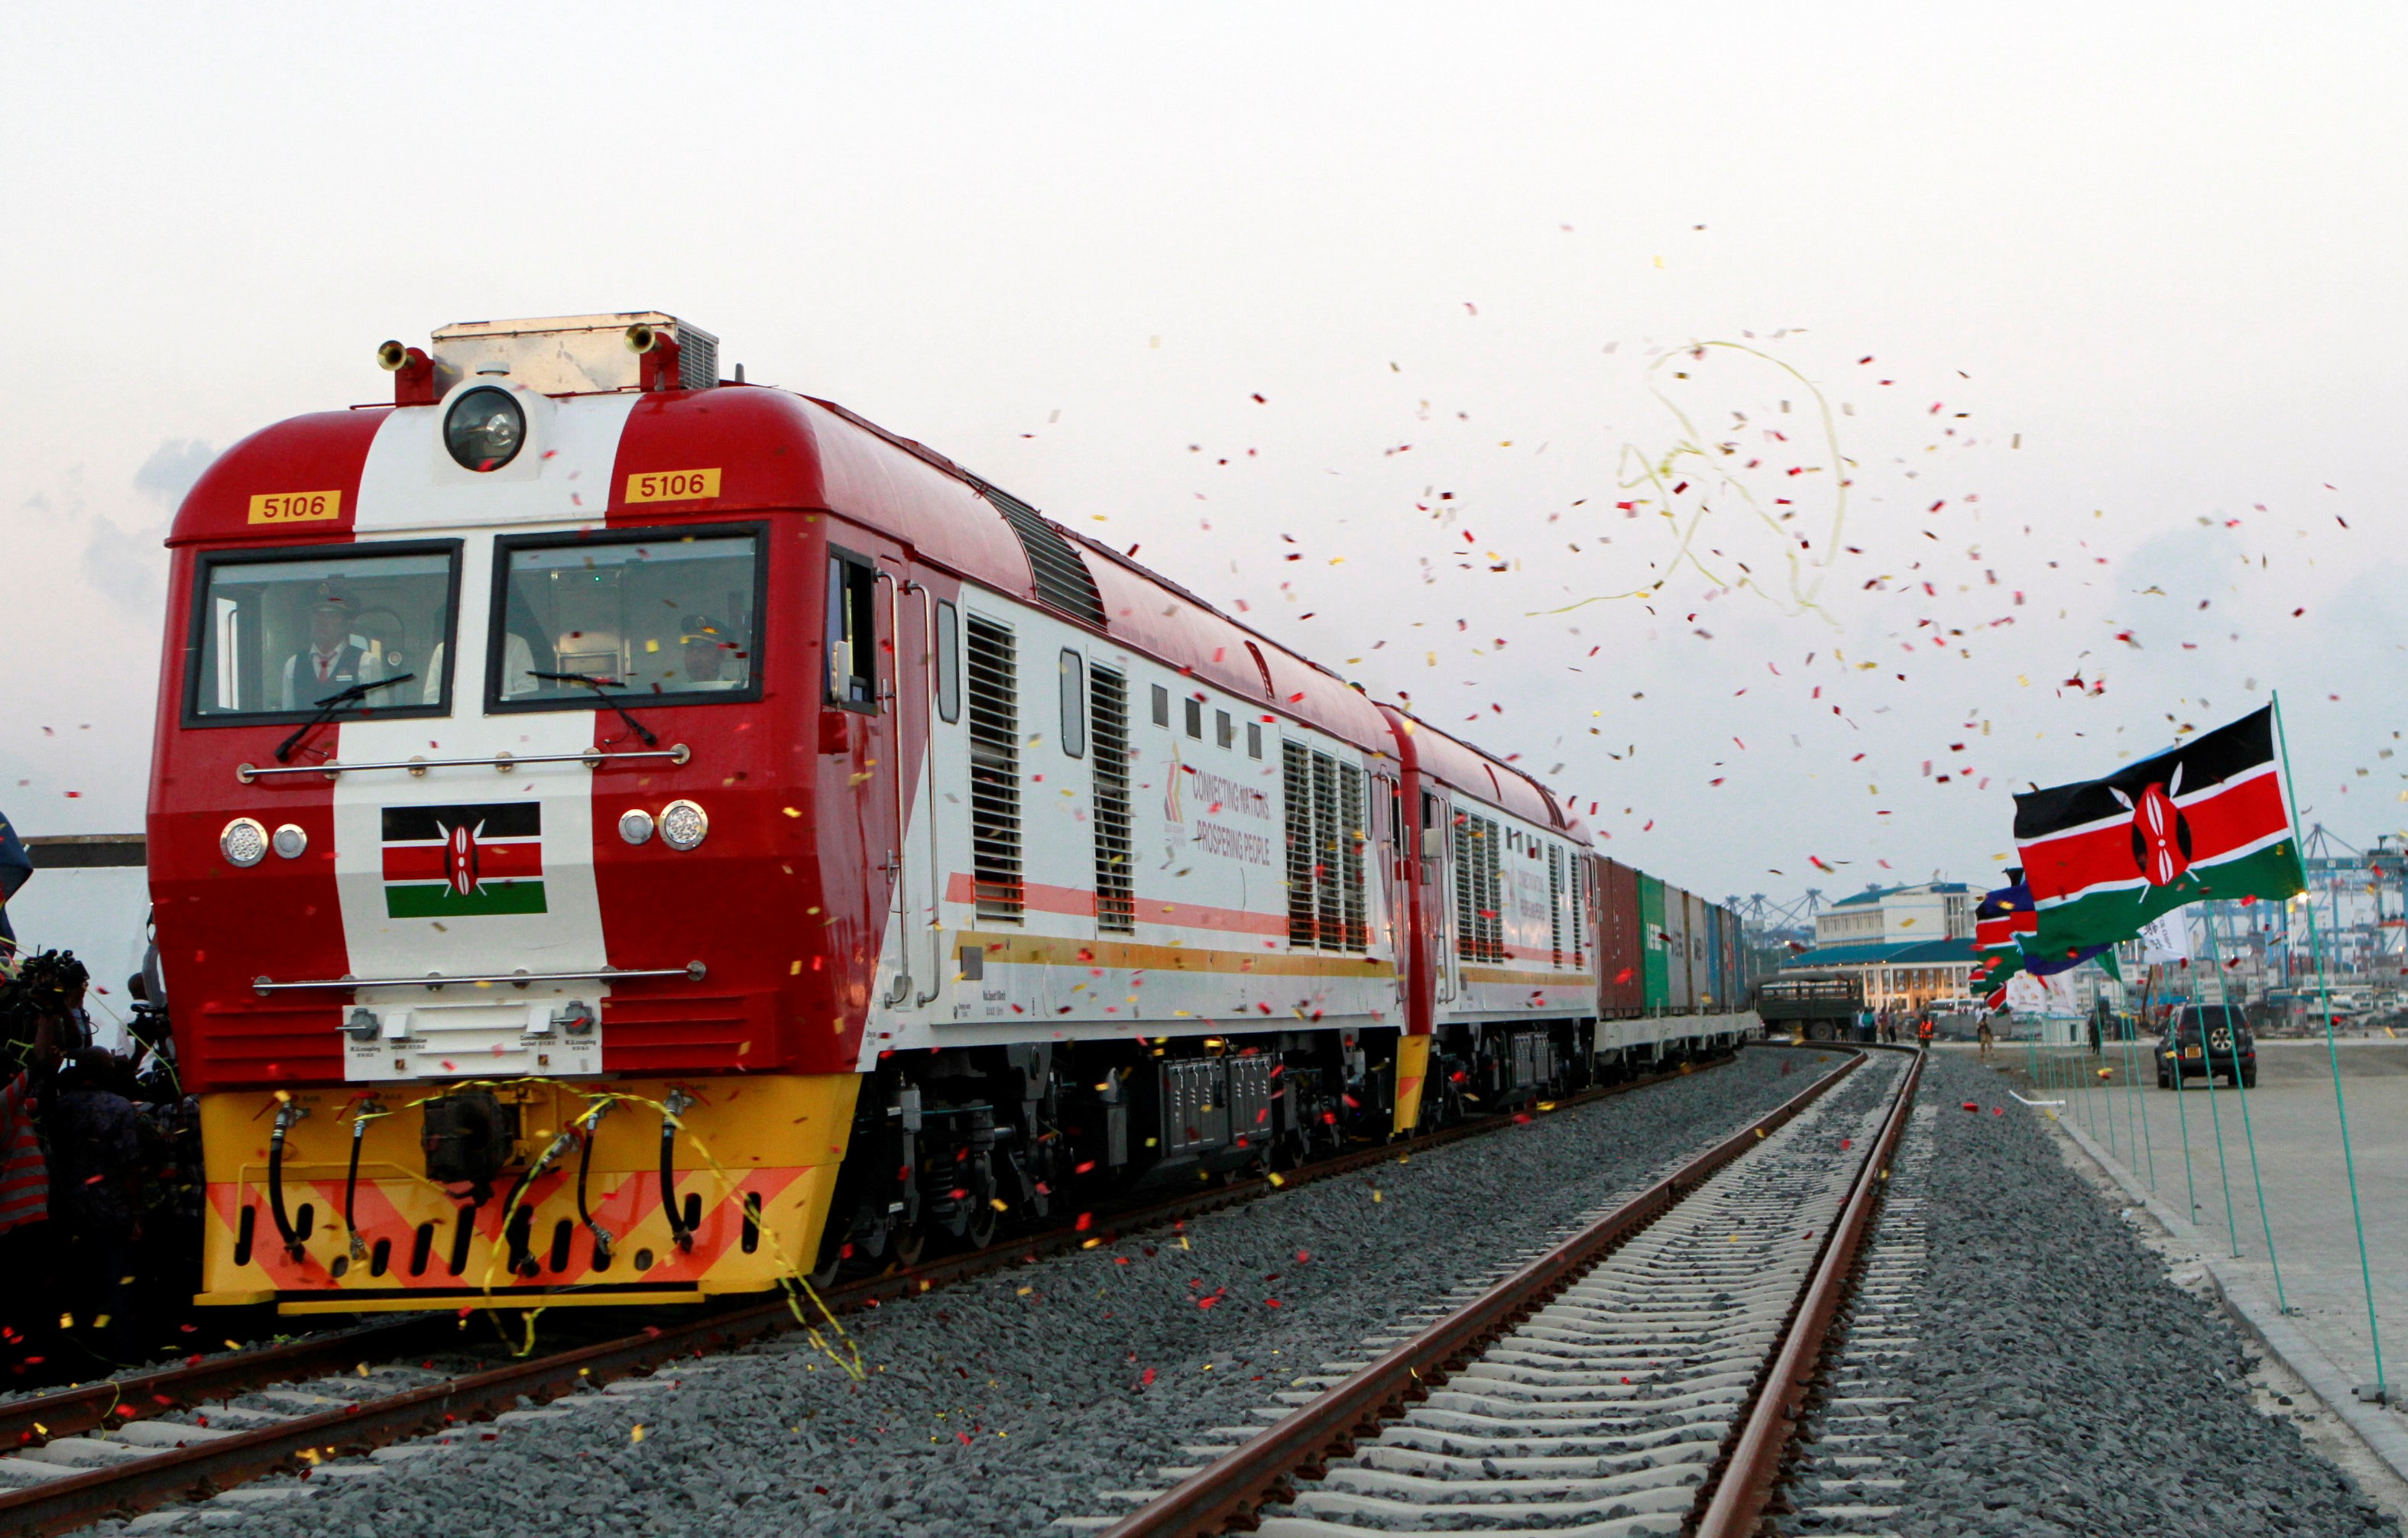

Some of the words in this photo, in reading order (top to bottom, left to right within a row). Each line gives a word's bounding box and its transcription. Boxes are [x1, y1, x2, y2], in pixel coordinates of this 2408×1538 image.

[640, 474, 705, 497] 5106
[263, 496, 326, 518] 5106
[1192, 769, 1239, 812] CONNECTING
[1197, 819, 1243, 861] PROSPERING
[1243, 832, 1270, 866] PEOPLE
